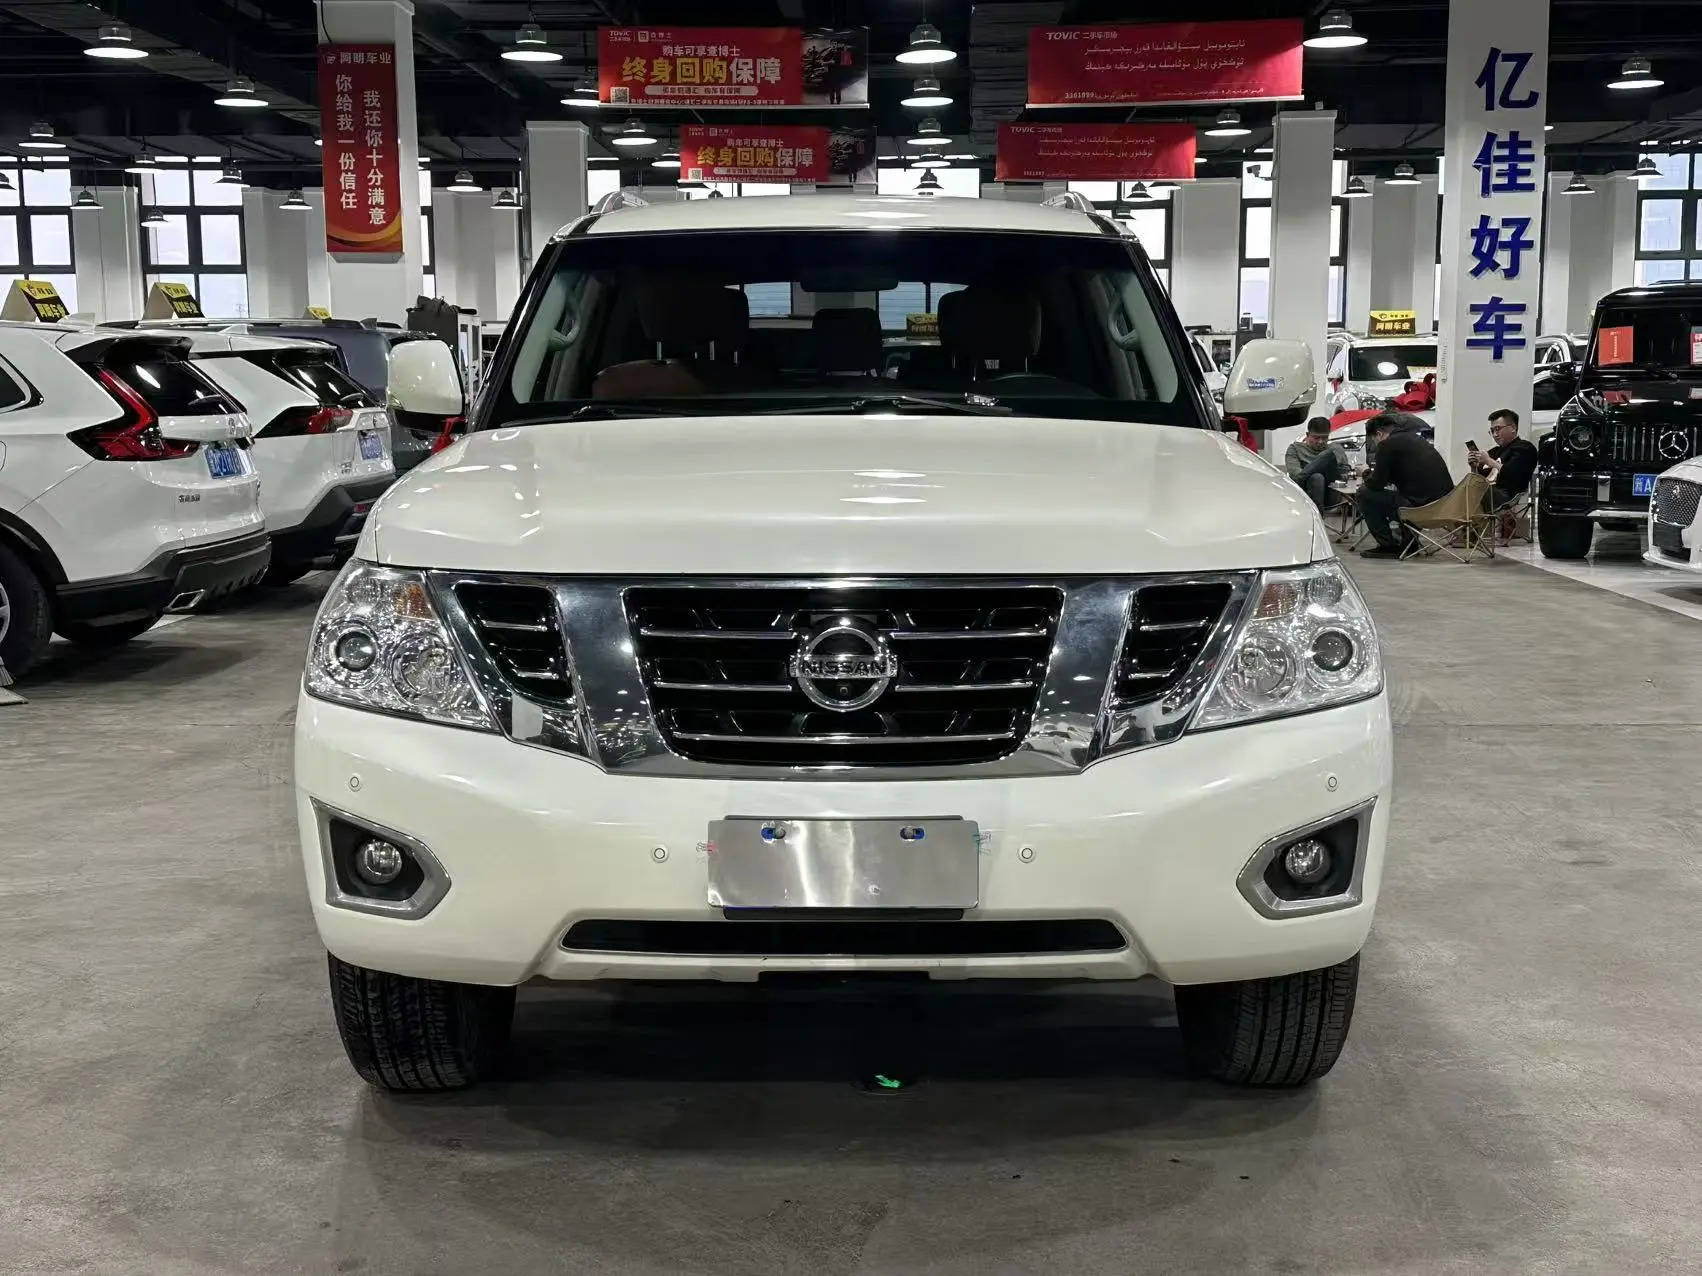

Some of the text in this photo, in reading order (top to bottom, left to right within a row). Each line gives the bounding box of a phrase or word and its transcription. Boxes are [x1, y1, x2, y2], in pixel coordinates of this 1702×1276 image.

[1046, 31, 1081, 40] TOVIC
[662, 45, 741, 57] 购车可享查博士
[621, 56, 783, 84] 终身回购保障
[336, 74, 358, 209] 你给我一份信任
[363, 90, 387, 225] 我还你十分满意
[697, 147, 814, 167] 终身回购保障
[1466, 47, 1540, 361] 亿佳好车
[800, 660, 888, 676] NISSAN
